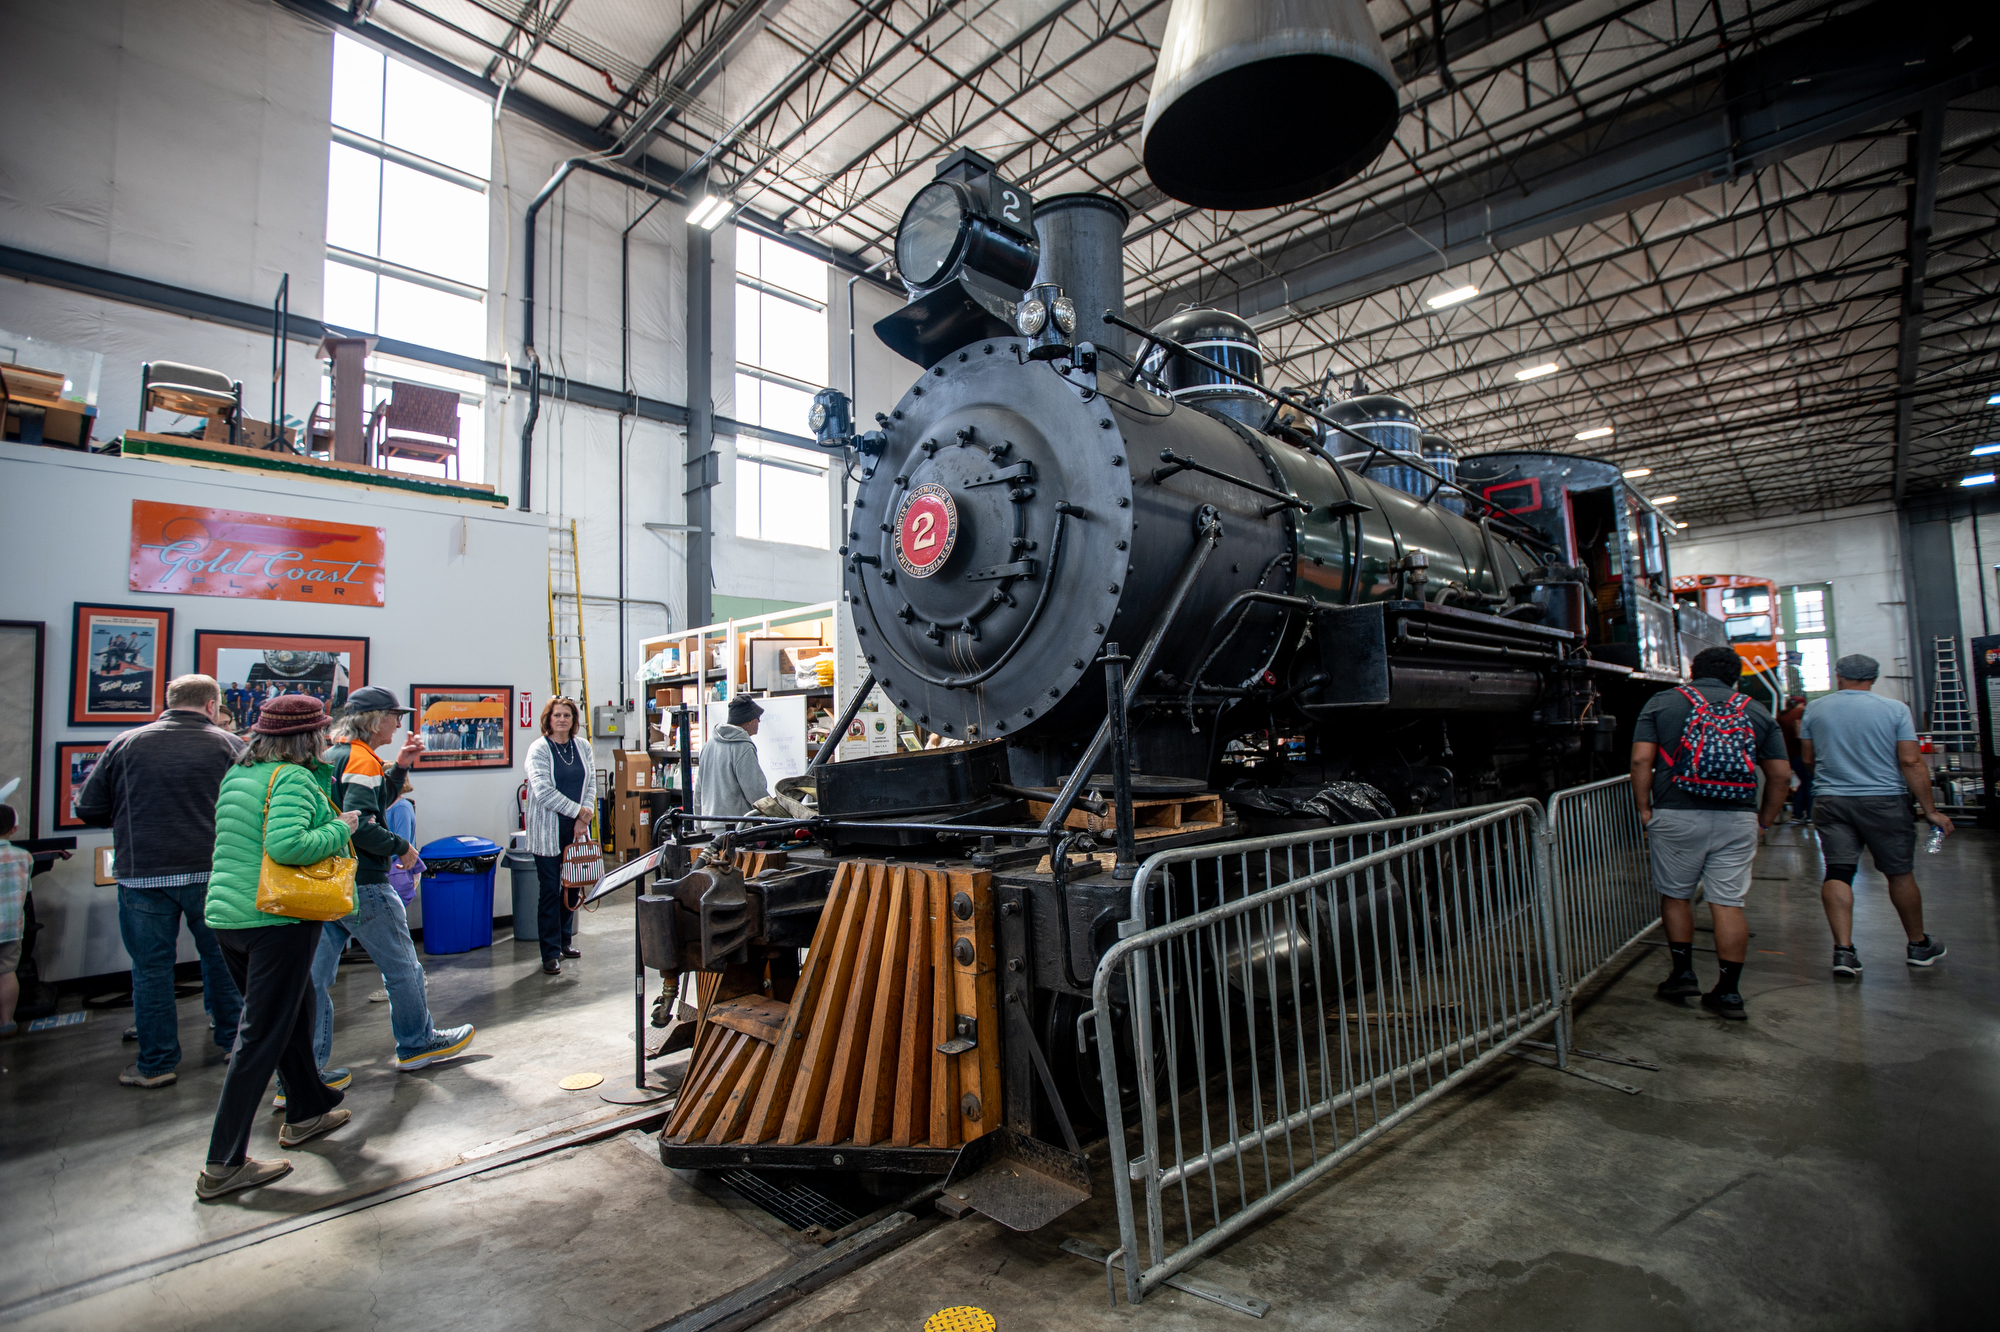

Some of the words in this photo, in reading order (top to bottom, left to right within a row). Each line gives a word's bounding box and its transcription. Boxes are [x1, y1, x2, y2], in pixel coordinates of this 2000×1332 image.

[1002, 190, 1020, 222] 2
[895, 507, 908, 549] BALDWIN
[906, 485, 947, 505] LOCOMOTIVE
[945, 498, 956, 530] WORKS
[911, 512, 935, 551] 2
[139, 540, 256, 583] Gold
[255, 551, 378, 585] Coast
[191, 577, 346, 595] FLYER
[121, 681, 143, 693] GUYS
